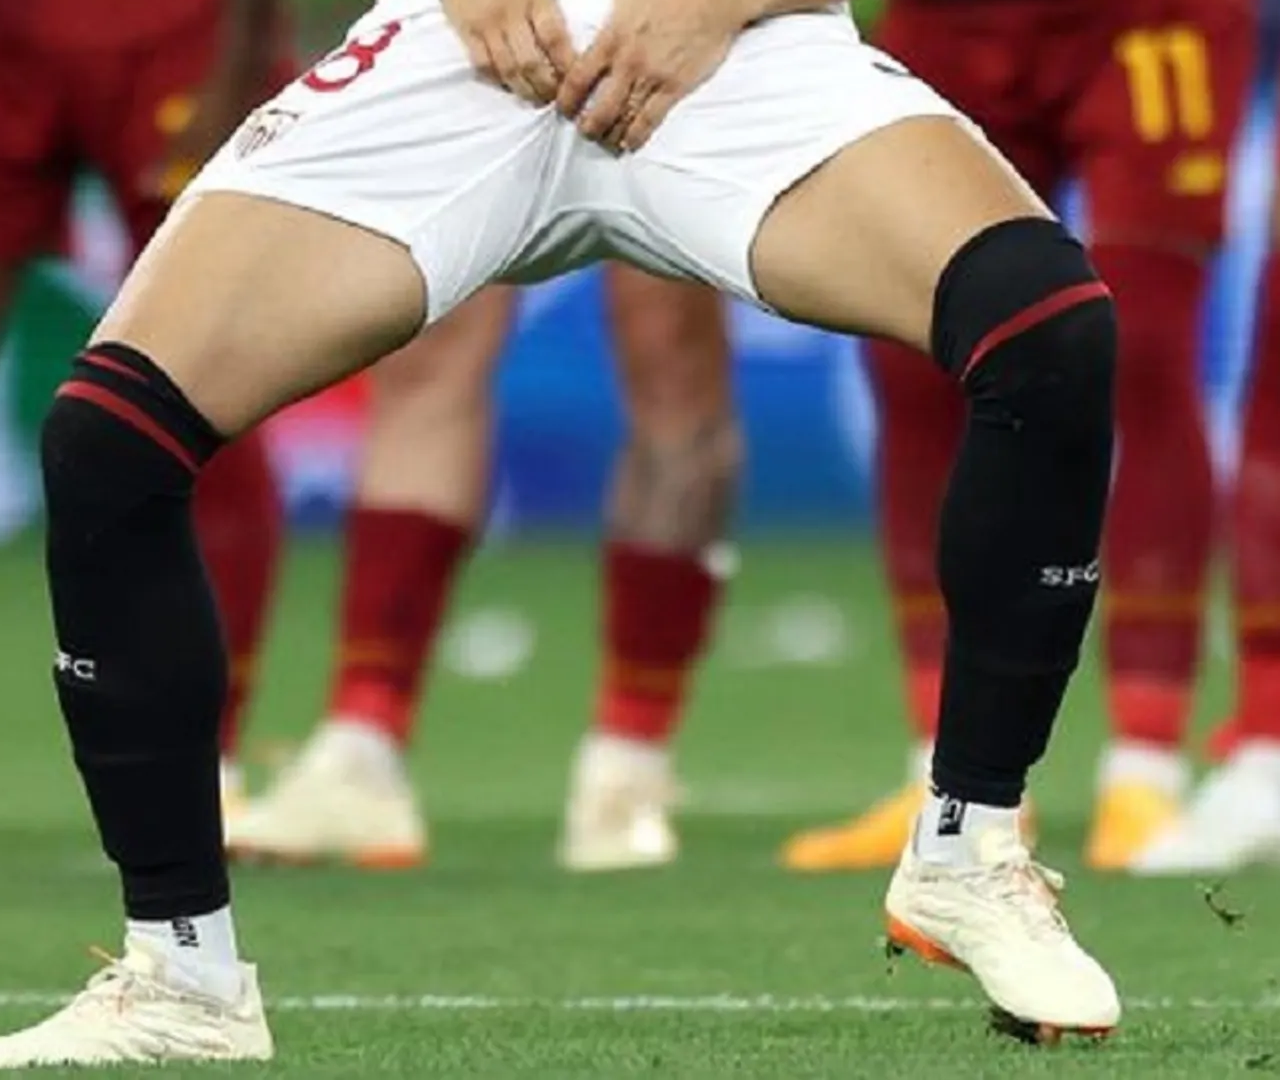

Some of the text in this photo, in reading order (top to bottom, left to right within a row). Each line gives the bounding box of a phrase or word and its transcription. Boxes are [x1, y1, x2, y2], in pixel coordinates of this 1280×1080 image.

[1115, 27, 1214, 143] 11
[1040, 559, 1099, 586] SFC
[54, 651, 95, 680] FC
